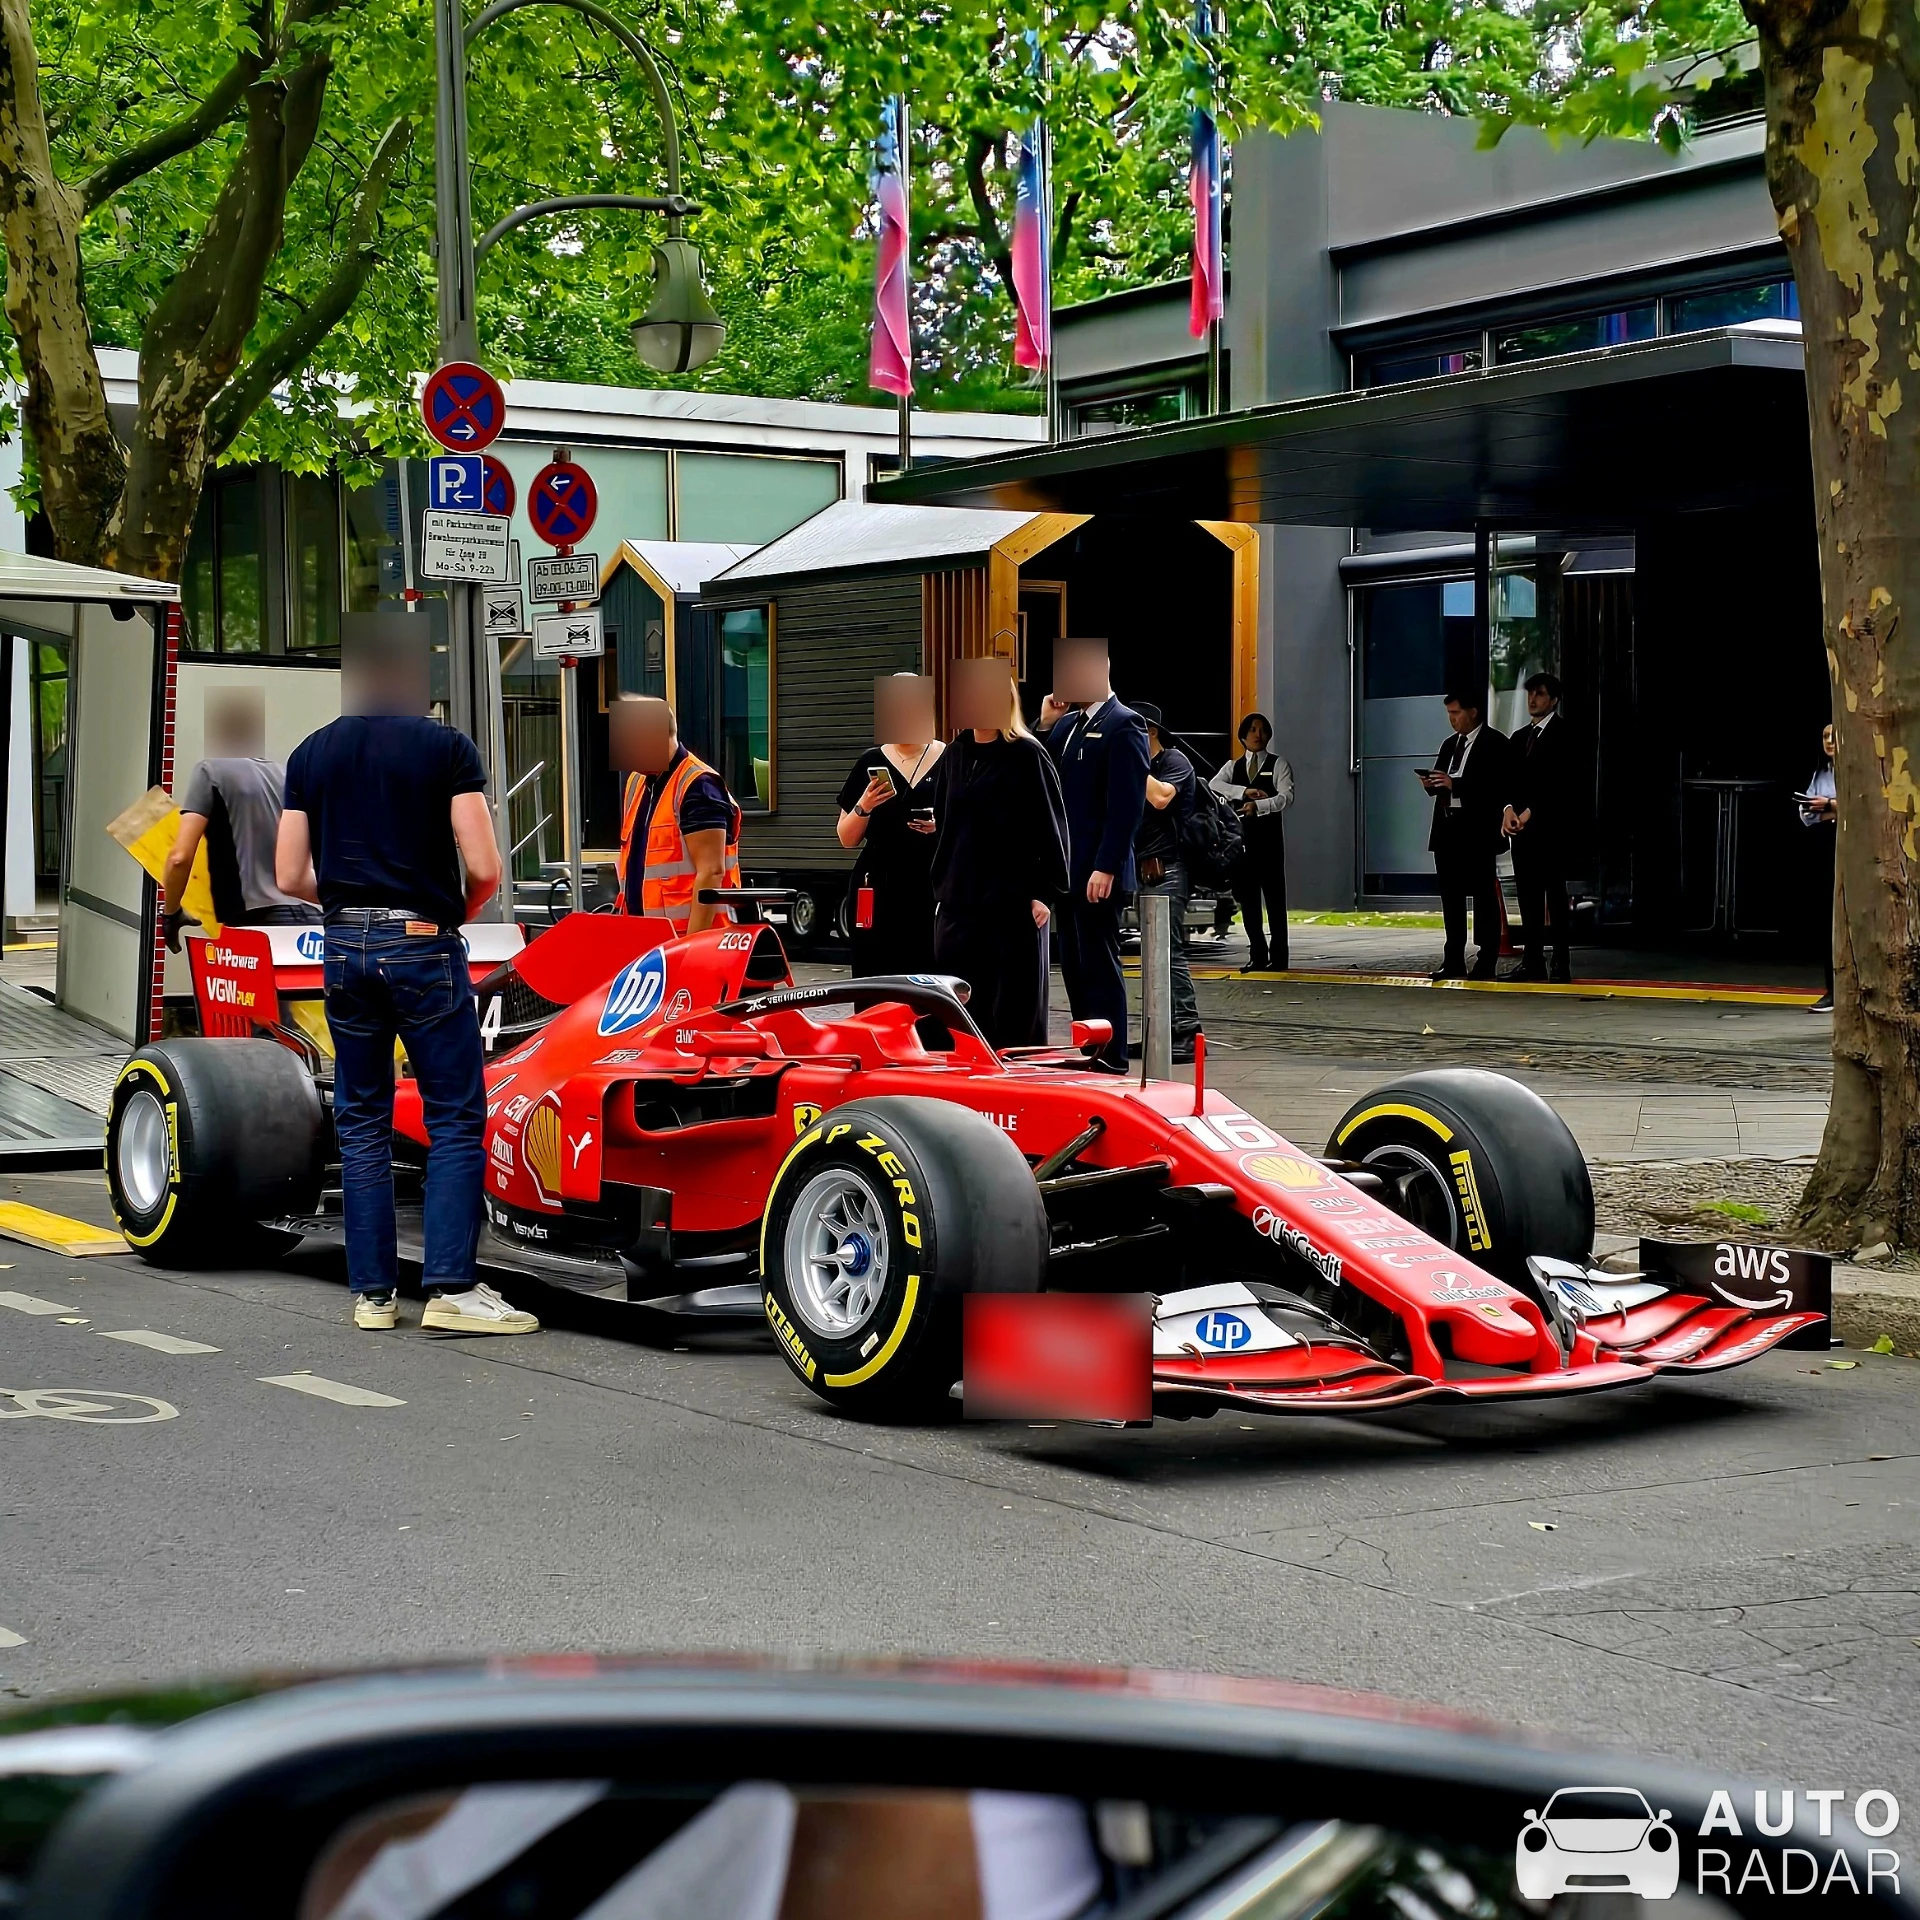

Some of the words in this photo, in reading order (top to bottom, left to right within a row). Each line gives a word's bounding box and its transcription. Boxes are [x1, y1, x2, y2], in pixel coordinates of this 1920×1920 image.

[439, 463, 467, 504] P
[435, 561, 466, 573] Mo-Sa
[536, 564, 549, 577] Ab
[215, 947, 259, 970] V-Power
[206, 976, 237, 1004] VGW
[236, 990, 256, 1007] PLAY
[603, 948, 662, 1034] hp
[675, 1029, 700, 1044] aw
[1169, 1113, 1279, 1152] 16
[826, 1124, 852, 1144] P
[856, 1131, 922, 1248] ZERO
[1449, 1149, 1492, 1251] PIRELLI
[1270, 1216, 1342, 1287] UniCredit
[1714, 1243, 1791, 1284] aws
[1430, 1286, 1510, 1302] UniCredit
[1204, 1311, 1244, 1350] hp
